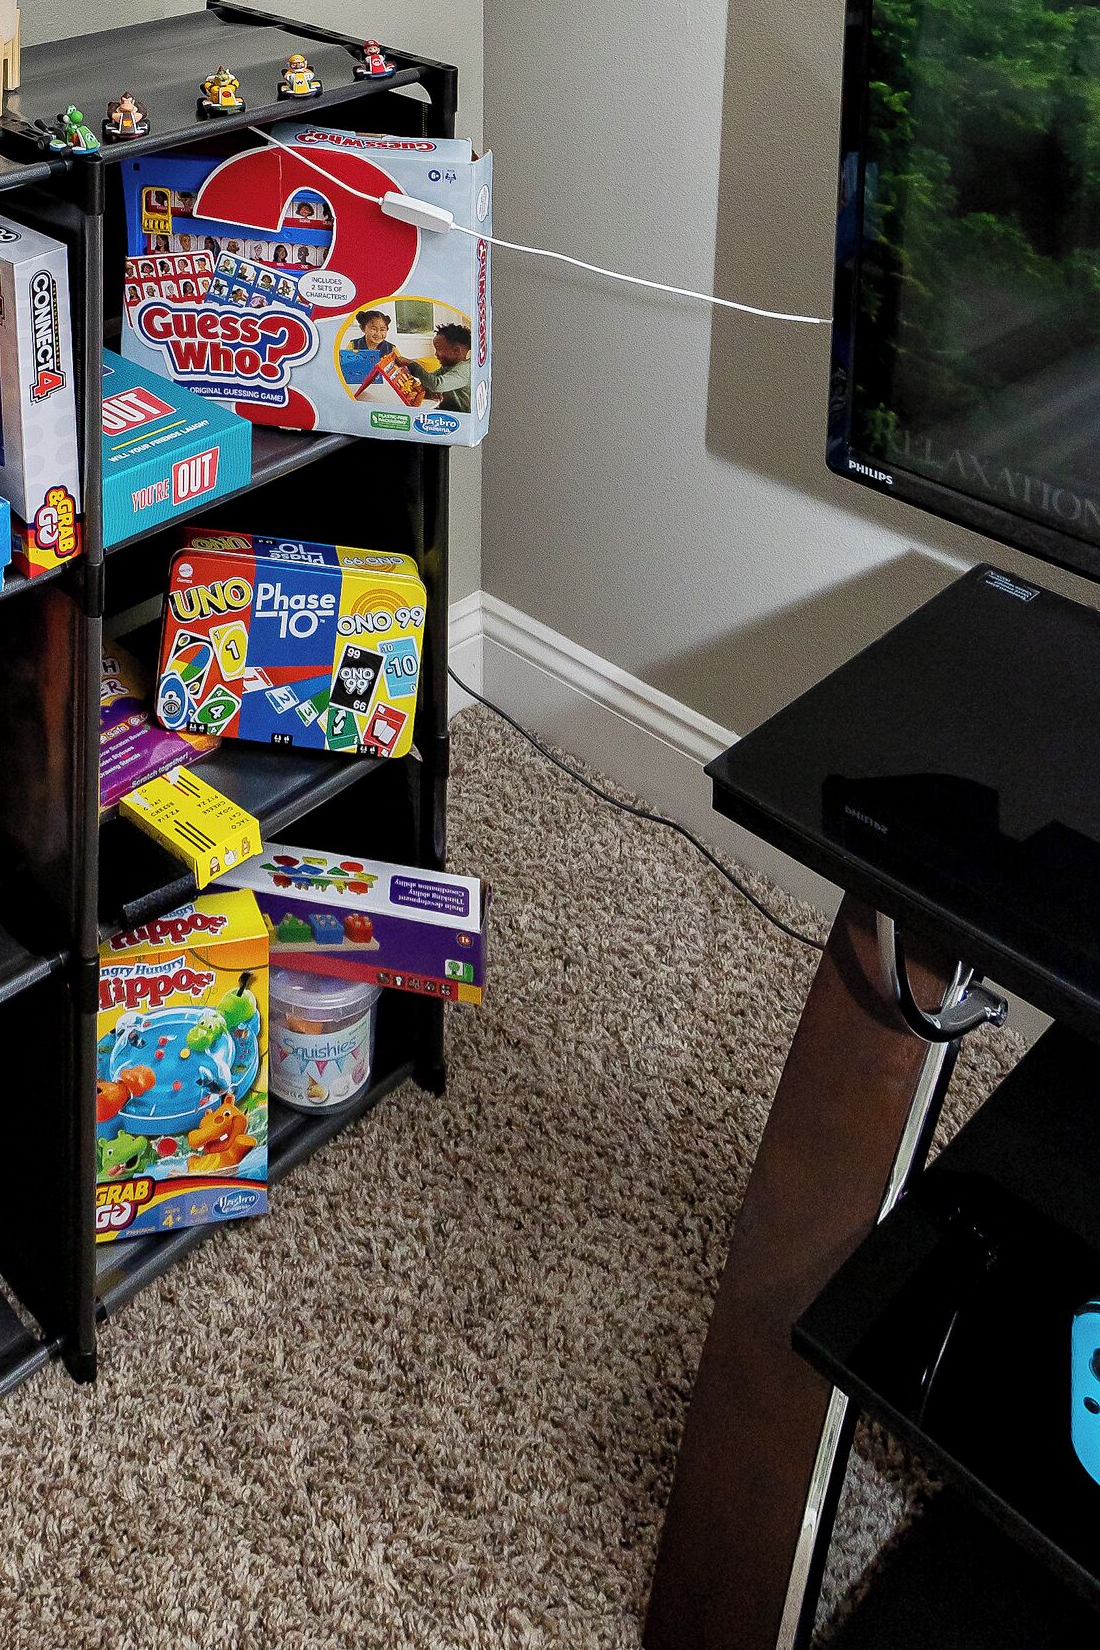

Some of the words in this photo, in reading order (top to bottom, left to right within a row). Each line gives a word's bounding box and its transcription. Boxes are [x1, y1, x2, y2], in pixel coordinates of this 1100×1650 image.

[311, 276, 343, 285] INCLUDES
[305, 291, 348, 301] CHARACTERS!
[32, 274, 55, 372] CONNECT
[142, 307, 262, 343] Guess
[33, 370, 65, 398] 4
[189, 386, 222, 396] ORIGINAL
[223, 388, 260, 399] GUESSING
[260, 391, 284, 402] GAME!
[420, 413, 457, 428] Hasbro
[108, 452, 128, 463] WILL
[128, 444, 151, 455] YOUR
[150, 430, 181, 448] FRIENDS
[181, 419, 210, 436] LAUGH?
[848, 458, 895, 486] PHILIPS
[131, 477, 170, 513] YOU'RE
[177, 452, 213, 498] OUT
[38, 507, 59, 545] GO
[57, 499, 76, 553] GRAB
[192, 535, 252, 550] UNO
[269, 551, 325, 564] Phase
[169, 577, 253, 623] UNO
[255, 582, 336, 610] Phase
[278, 609, 319, 639] 10
[337, 612, 392, 636] ONO
[394, 606, 425, 629] 99
[226, 640, 240, 660] 1
[347, 647, 361, 659] 99
[339, 667, 375, 681] ONO
[386, 654, 419, 678] -10
[344, 678, 370, 696] 99
[210, 705, 226, 720] 4
[106, 723, 129, 738] Safe
[131, 768, 158, 789] Scratch
[158, 751, 190, 773] together!
[150, 801, 175, 817] CHEESE
[196, 794, 219, 808] PIZZA
[201, 800, 226, 815] CHEESE
[157, 808, 180, 823] PIZZA
[228, 811, 242, 821] CAT
[231, 817, 250, 830] TACO
[394, 878, 417, 889] ability
[417, 884, 465, 897] Coordination
[398, 894, 444, 909] development
[408, 888, 431, 900] ability
[431, 892, 465, 906] Thinking
[444, 903, 465, 913] Brain
[134, 956, 185, 976] Hungry
[282, 1036, 357, 1060] Squishies
[96, 1180, 149, 1205] GRAB
[218, 1194, 256, 1208] Hasbro
[96, 1202, 132, 1229] GO
